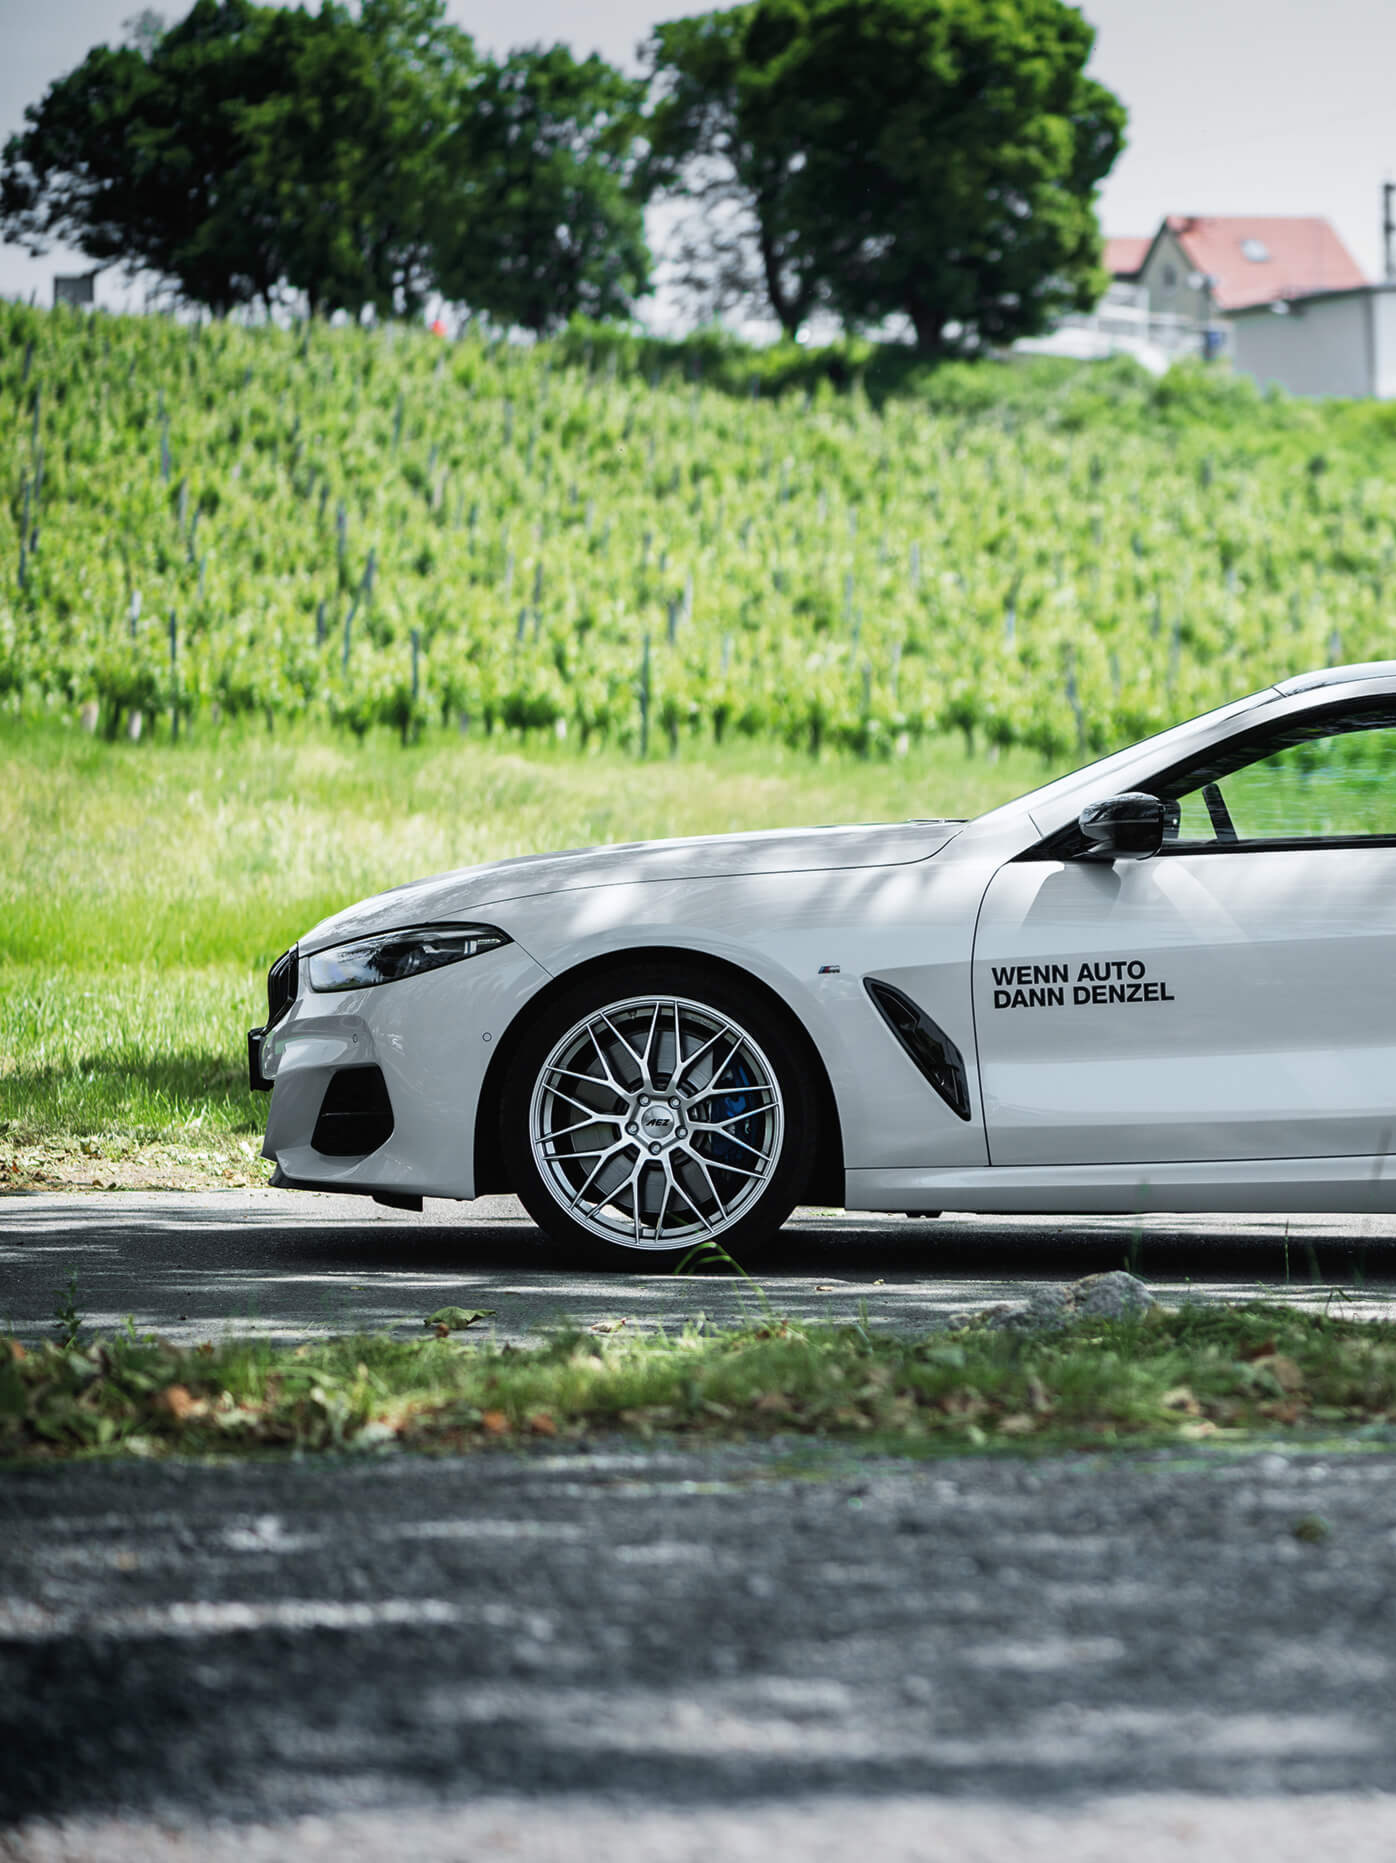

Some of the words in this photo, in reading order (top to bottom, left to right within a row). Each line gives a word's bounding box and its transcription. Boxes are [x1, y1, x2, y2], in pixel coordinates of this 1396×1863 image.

[991, 964, 1069, 986] WENN
[1077, 960, 1146, 982] AUTO
[993, 986, 1064, 1008] DANN
[1073, 982, 1175, 1005] DENZEL
[645, 1118, 670, 1127] AEZ
